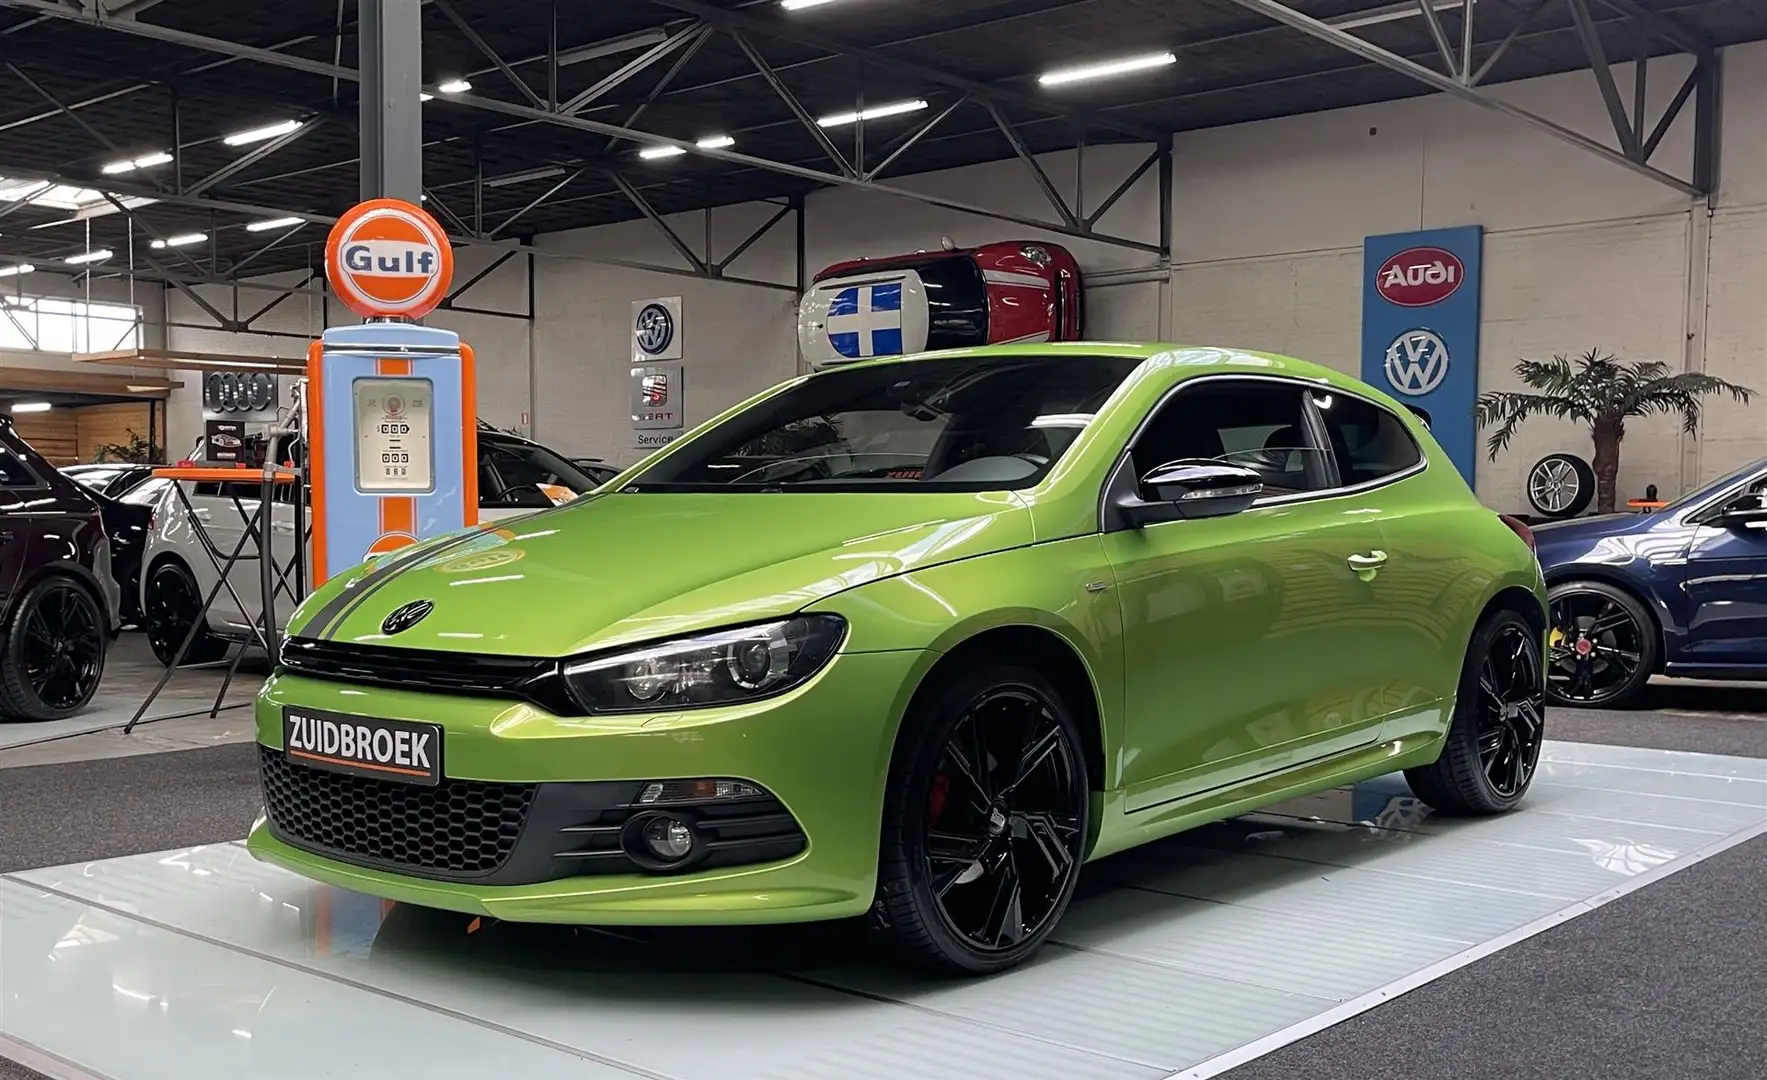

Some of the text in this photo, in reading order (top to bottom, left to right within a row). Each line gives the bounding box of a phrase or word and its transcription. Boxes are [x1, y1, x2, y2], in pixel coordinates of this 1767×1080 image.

[345, 245, 433, 273] Gulf
[638, 434, 674, 445] Service
[289, 715, 431, 768] ZUIDBROEK
